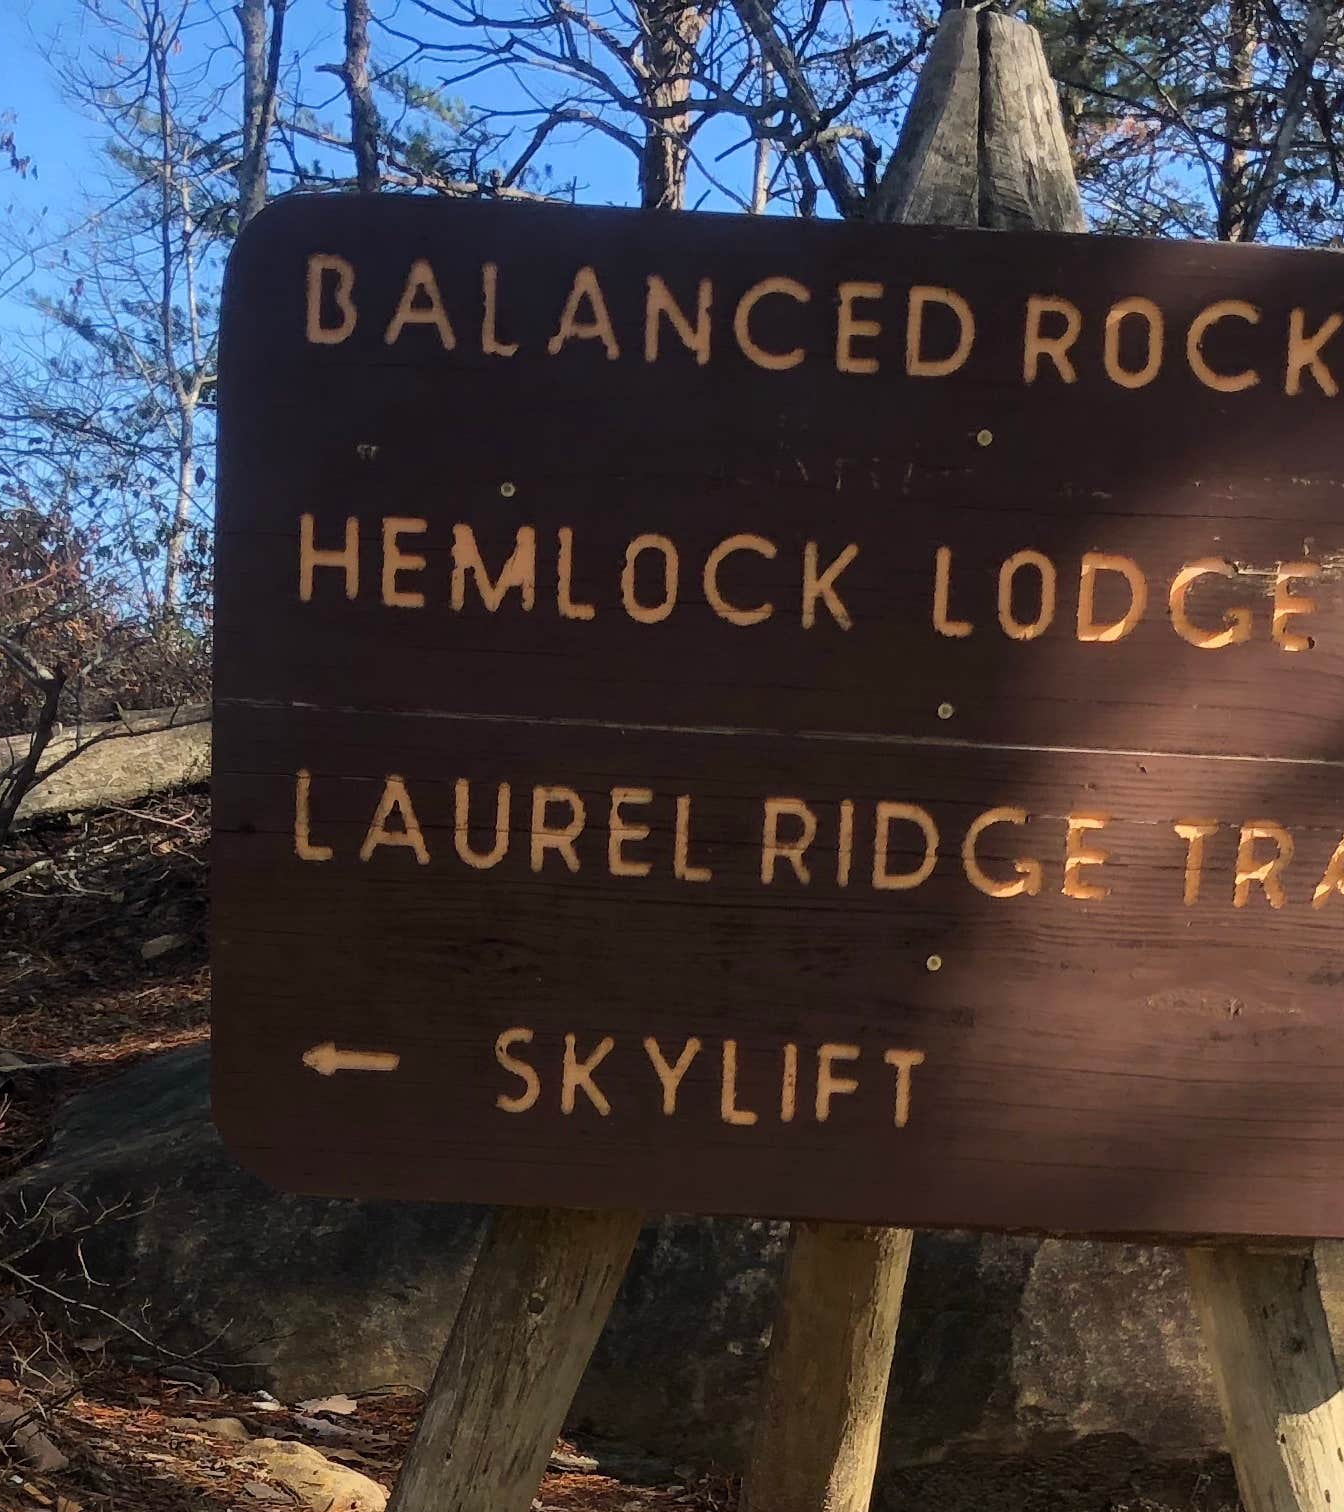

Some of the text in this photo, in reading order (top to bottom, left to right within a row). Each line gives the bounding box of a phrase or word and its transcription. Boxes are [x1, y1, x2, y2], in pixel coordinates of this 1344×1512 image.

[305, 252, 976, 378] BALANCED
[1023, 294, 1344, 398] ROCK
[298, 512, 1320, 652] HEMLOCK LODGE
[294, 767, 713, 883] LAUREL
[760, 797, 1112, 901] RIDGE
[494, 1026, 926, 1129] SKYLIFT
